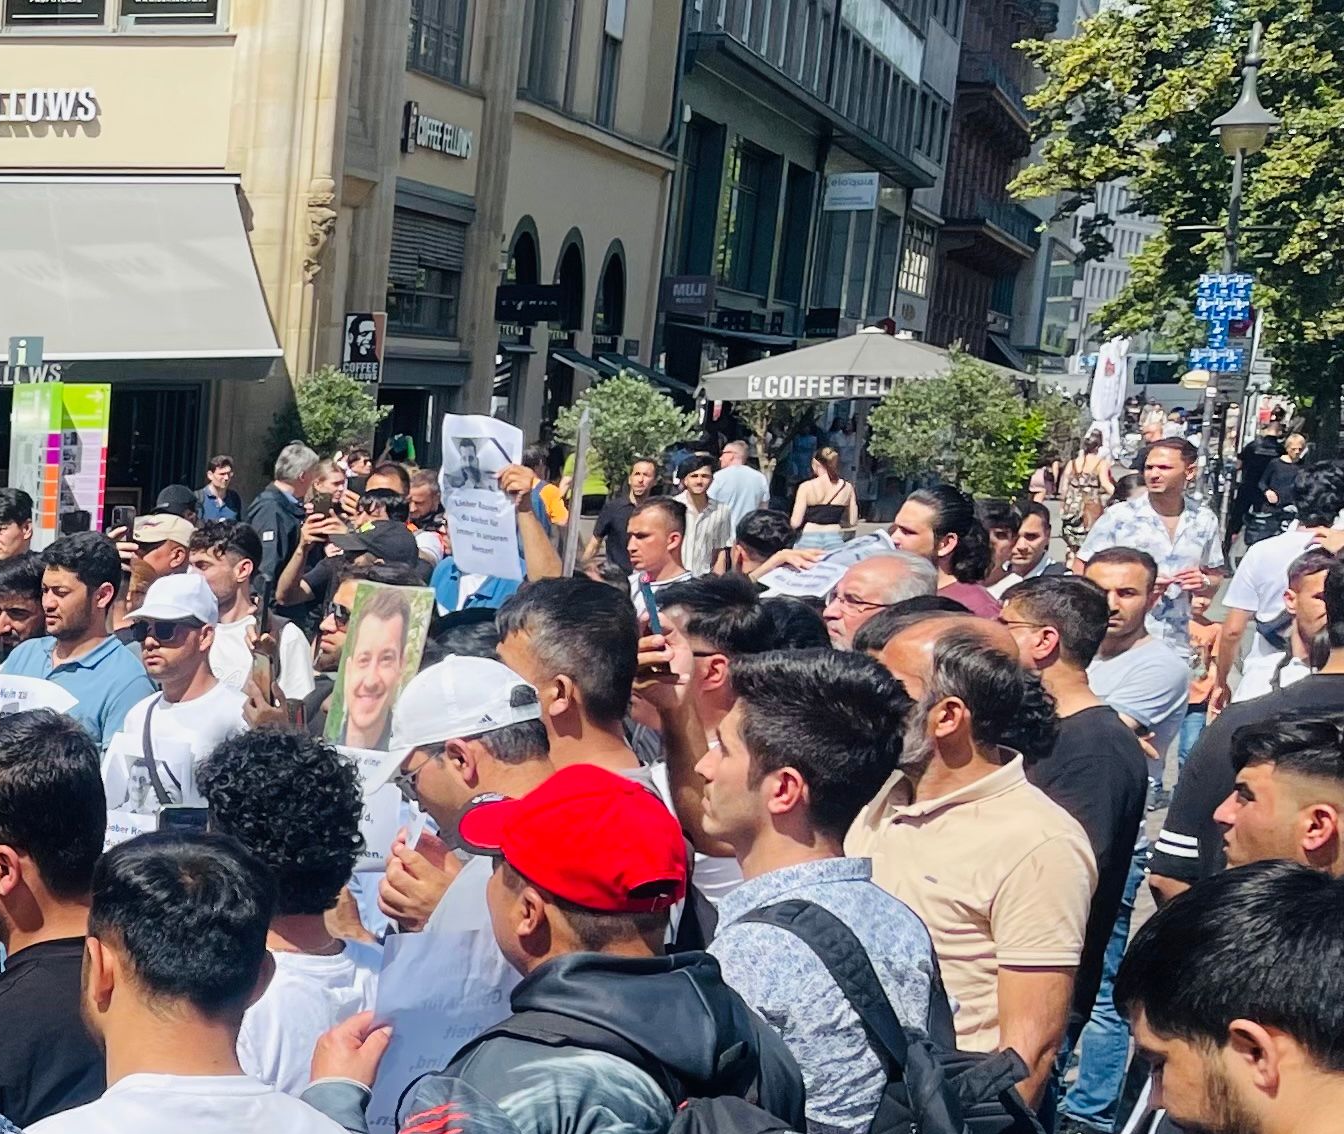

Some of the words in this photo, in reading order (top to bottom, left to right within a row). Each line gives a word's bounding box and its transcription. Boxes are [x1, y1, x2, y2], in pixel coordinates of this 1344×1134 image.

[673, 283, 707, 297] MUJI
[343, 362, 379, 373] COFFEE
[764, 375, 846, 399] COFFEE
